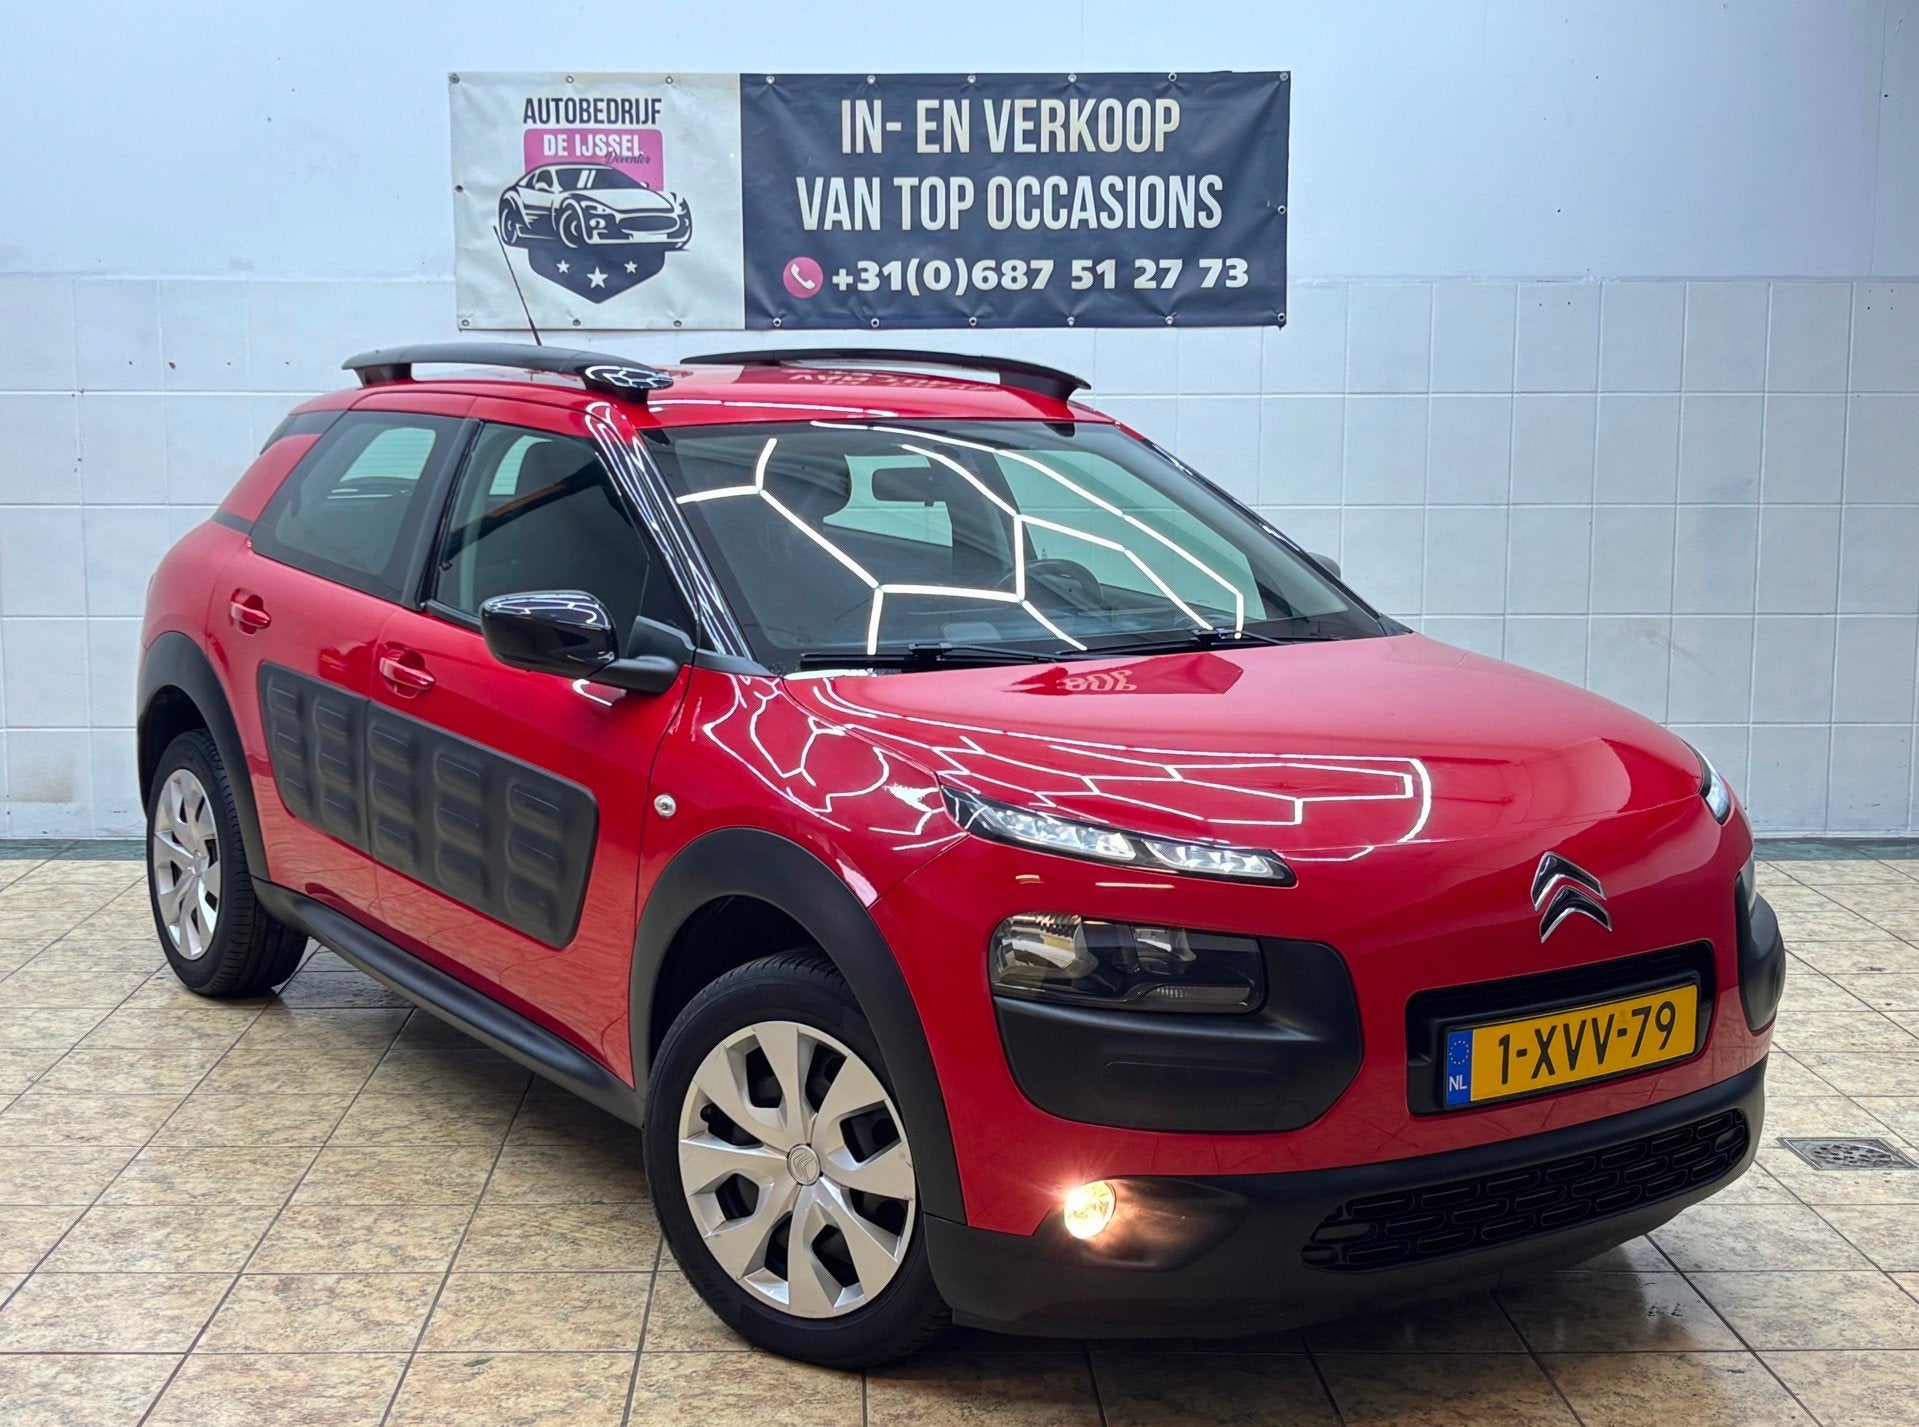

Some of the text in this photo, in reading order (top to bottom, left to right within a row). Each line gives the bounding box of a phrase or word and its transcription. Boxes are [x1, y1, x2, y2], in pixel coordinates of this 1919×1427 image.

[523, 97, 662, 125] AUTOBEDRIJF
[841, 97, 1181, 154] IN- EN VERKOOP
[543, 134, 644, 157] DE IJSSEL
[796, 174, 1223, 231] VAN TOP OCCASIONS
[832, 257, 1250, 297] +31(0)687 51 27 73
[1498, 1001, 1677, 1085] 1-XVV-79
[1448, 1074, 1468, 1092] NL
